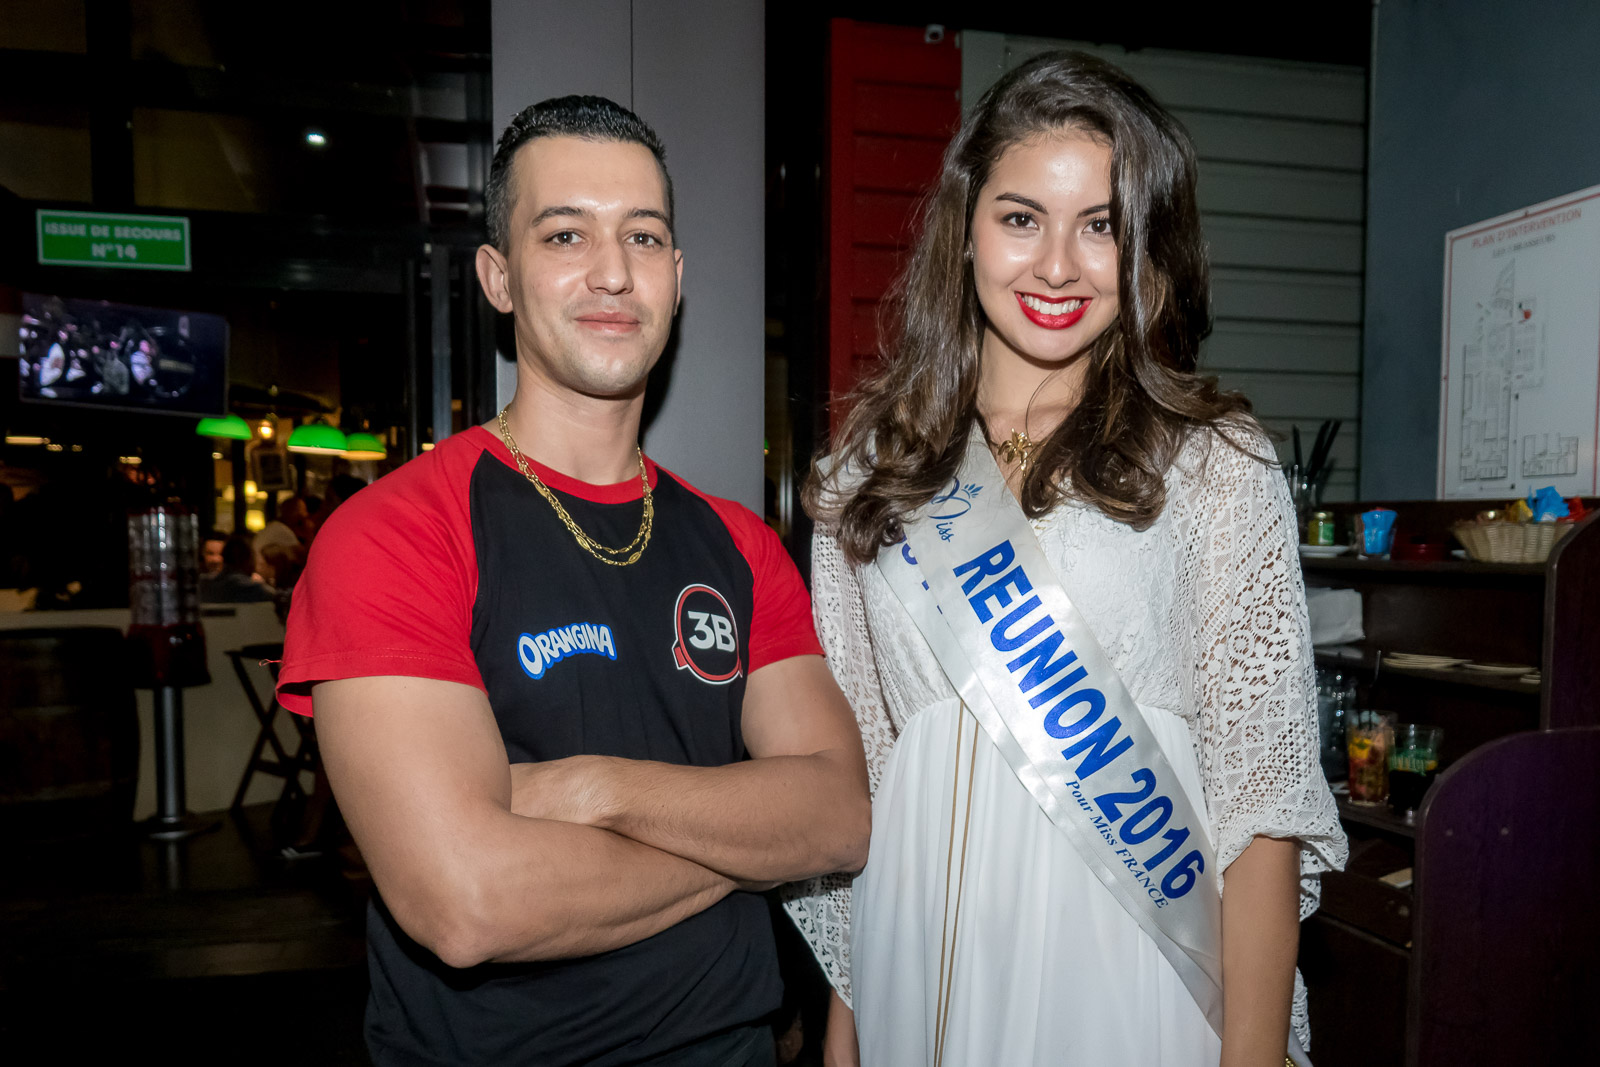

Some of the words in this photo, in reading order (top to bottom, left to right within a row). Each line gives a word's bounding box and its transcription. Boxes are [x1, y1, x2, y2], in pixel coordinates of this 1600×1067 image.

[45, 222, 86, 236] ISSUE
[91, 225, 109, 237] DE
[114, 226, 181, 241] SECOURS
[518, 622, 616, 677] ORANGINA
[688, 610, 736, 652] 3B
[953, 539, 1135, 781] REUNION
[1093, 768, 1205, 899] 2016
[1065, 780, 1094, 812] Pour
[1090, 815, 1118, 846] Miss
[1115, 848, 1169, 909] FRANCE
